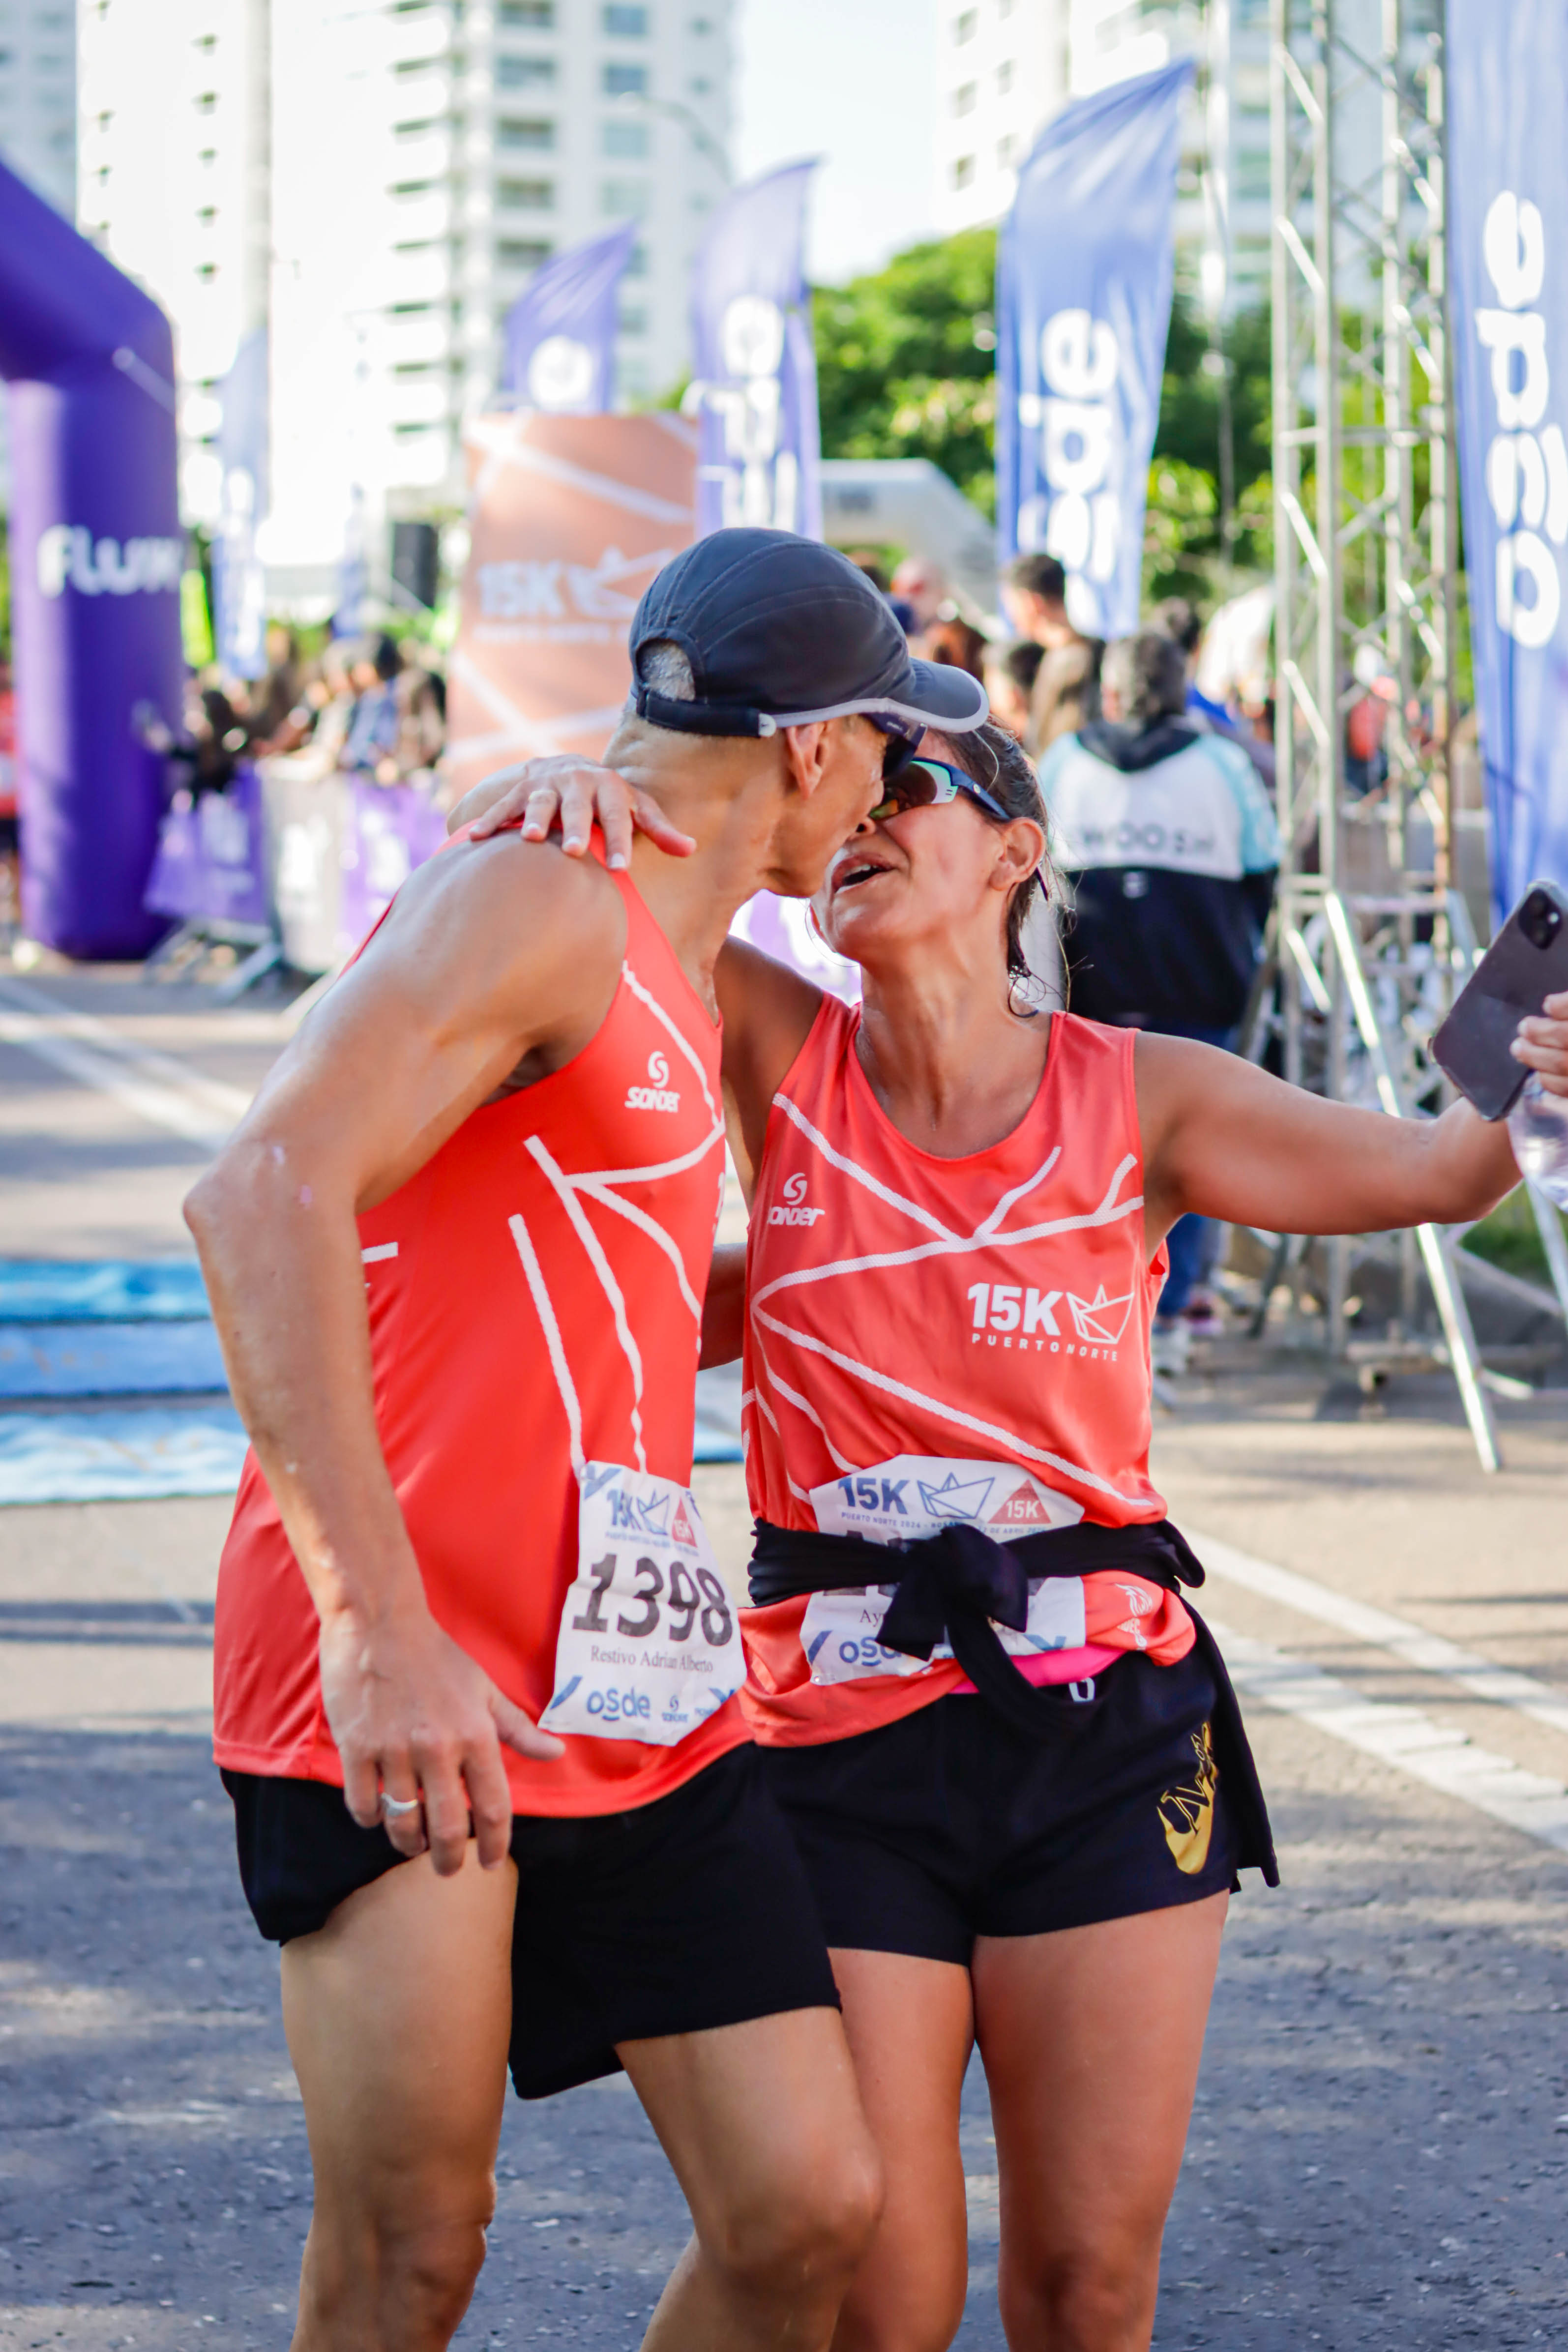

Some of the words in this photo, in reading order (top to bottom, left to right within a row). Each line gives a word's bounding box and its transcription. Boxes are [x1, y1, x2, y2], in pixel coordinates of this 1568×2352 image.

[967, 1282, 1064, 1336] 15K
[972, 1333, 1060, 1353] PUERTO
[1066, 1343, 1118, 1361] NORTE
[838, 1477, 910, 1515] 15K
[1006, 1499, 1039, 1519] 15K
[572, 1553, 733, 1647] 1398
[591, 1645, 636, 1665] Restivo
[587, 1685, 651, 1721] osde
